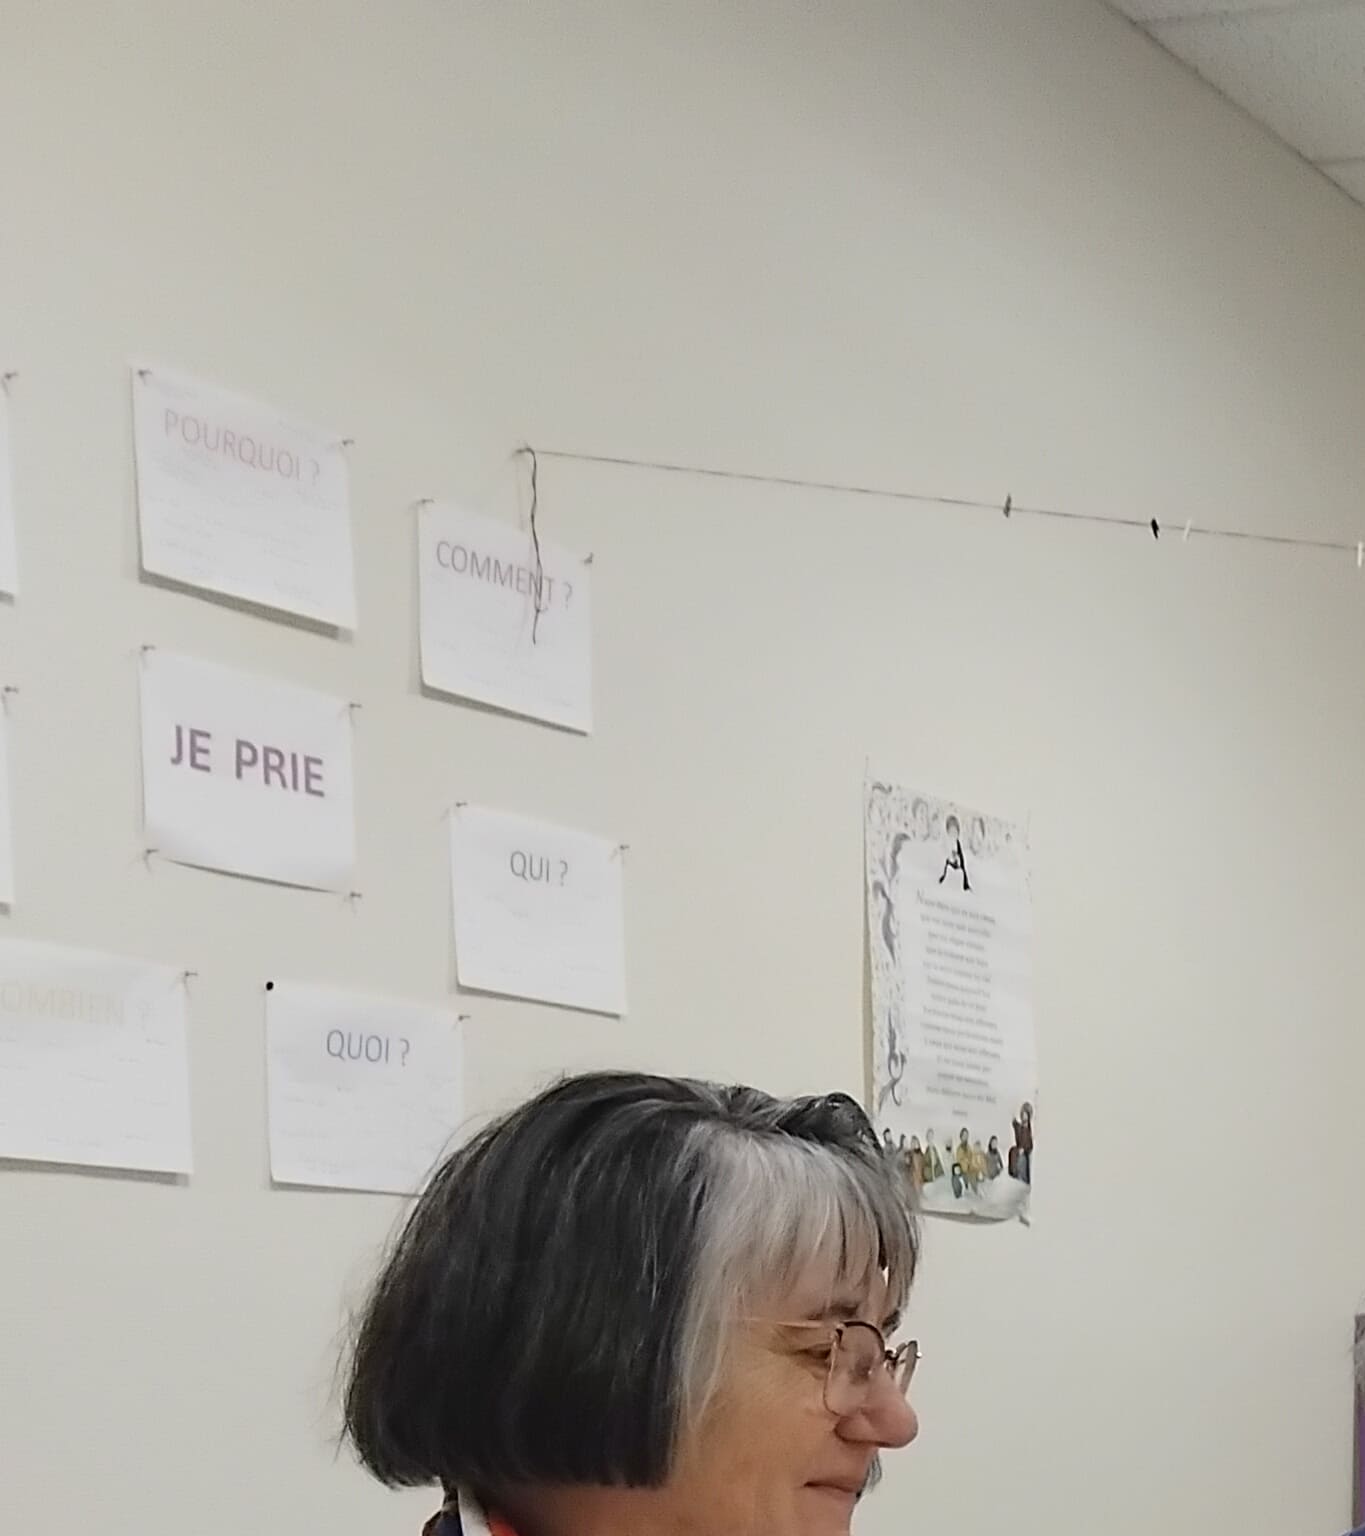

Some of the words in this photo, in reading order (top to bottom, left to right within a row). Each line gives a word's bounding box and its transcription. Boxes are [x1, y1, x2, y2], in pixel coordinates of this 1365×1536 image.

[164, 408, 300, 480] POURQUOI
[436, 540, 556, 604] COMMENT
[170, 725, 211, 773] JE
[235, 739, 325, 797] PRIE
[510, 850, 550, 883] QUI
[326, 1029, 389, 1064] QUOI
